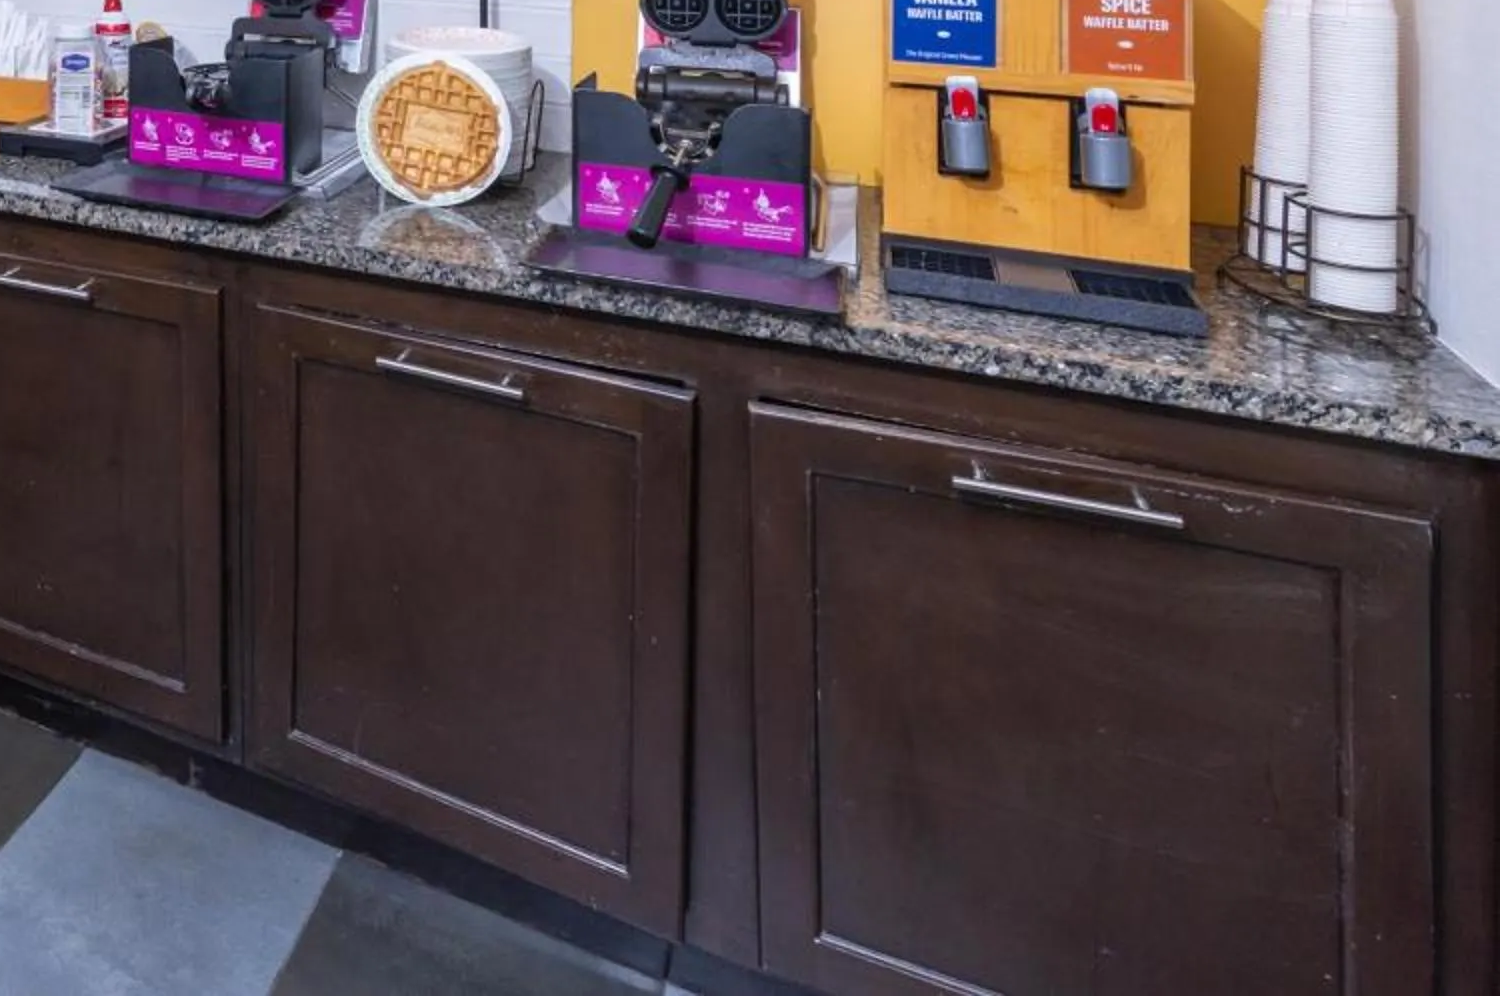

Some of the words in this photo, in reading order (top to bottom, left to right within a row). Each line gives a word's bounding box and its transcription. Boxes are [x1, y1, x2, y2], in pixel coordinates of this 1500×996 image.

[907, 7, 943, 21] WAFFLE
[945, 9, 983, 23] BATTER
[1083, 15, 1125, 29] WAFFLE
[1127, 18, 1169, 32] BATTER
